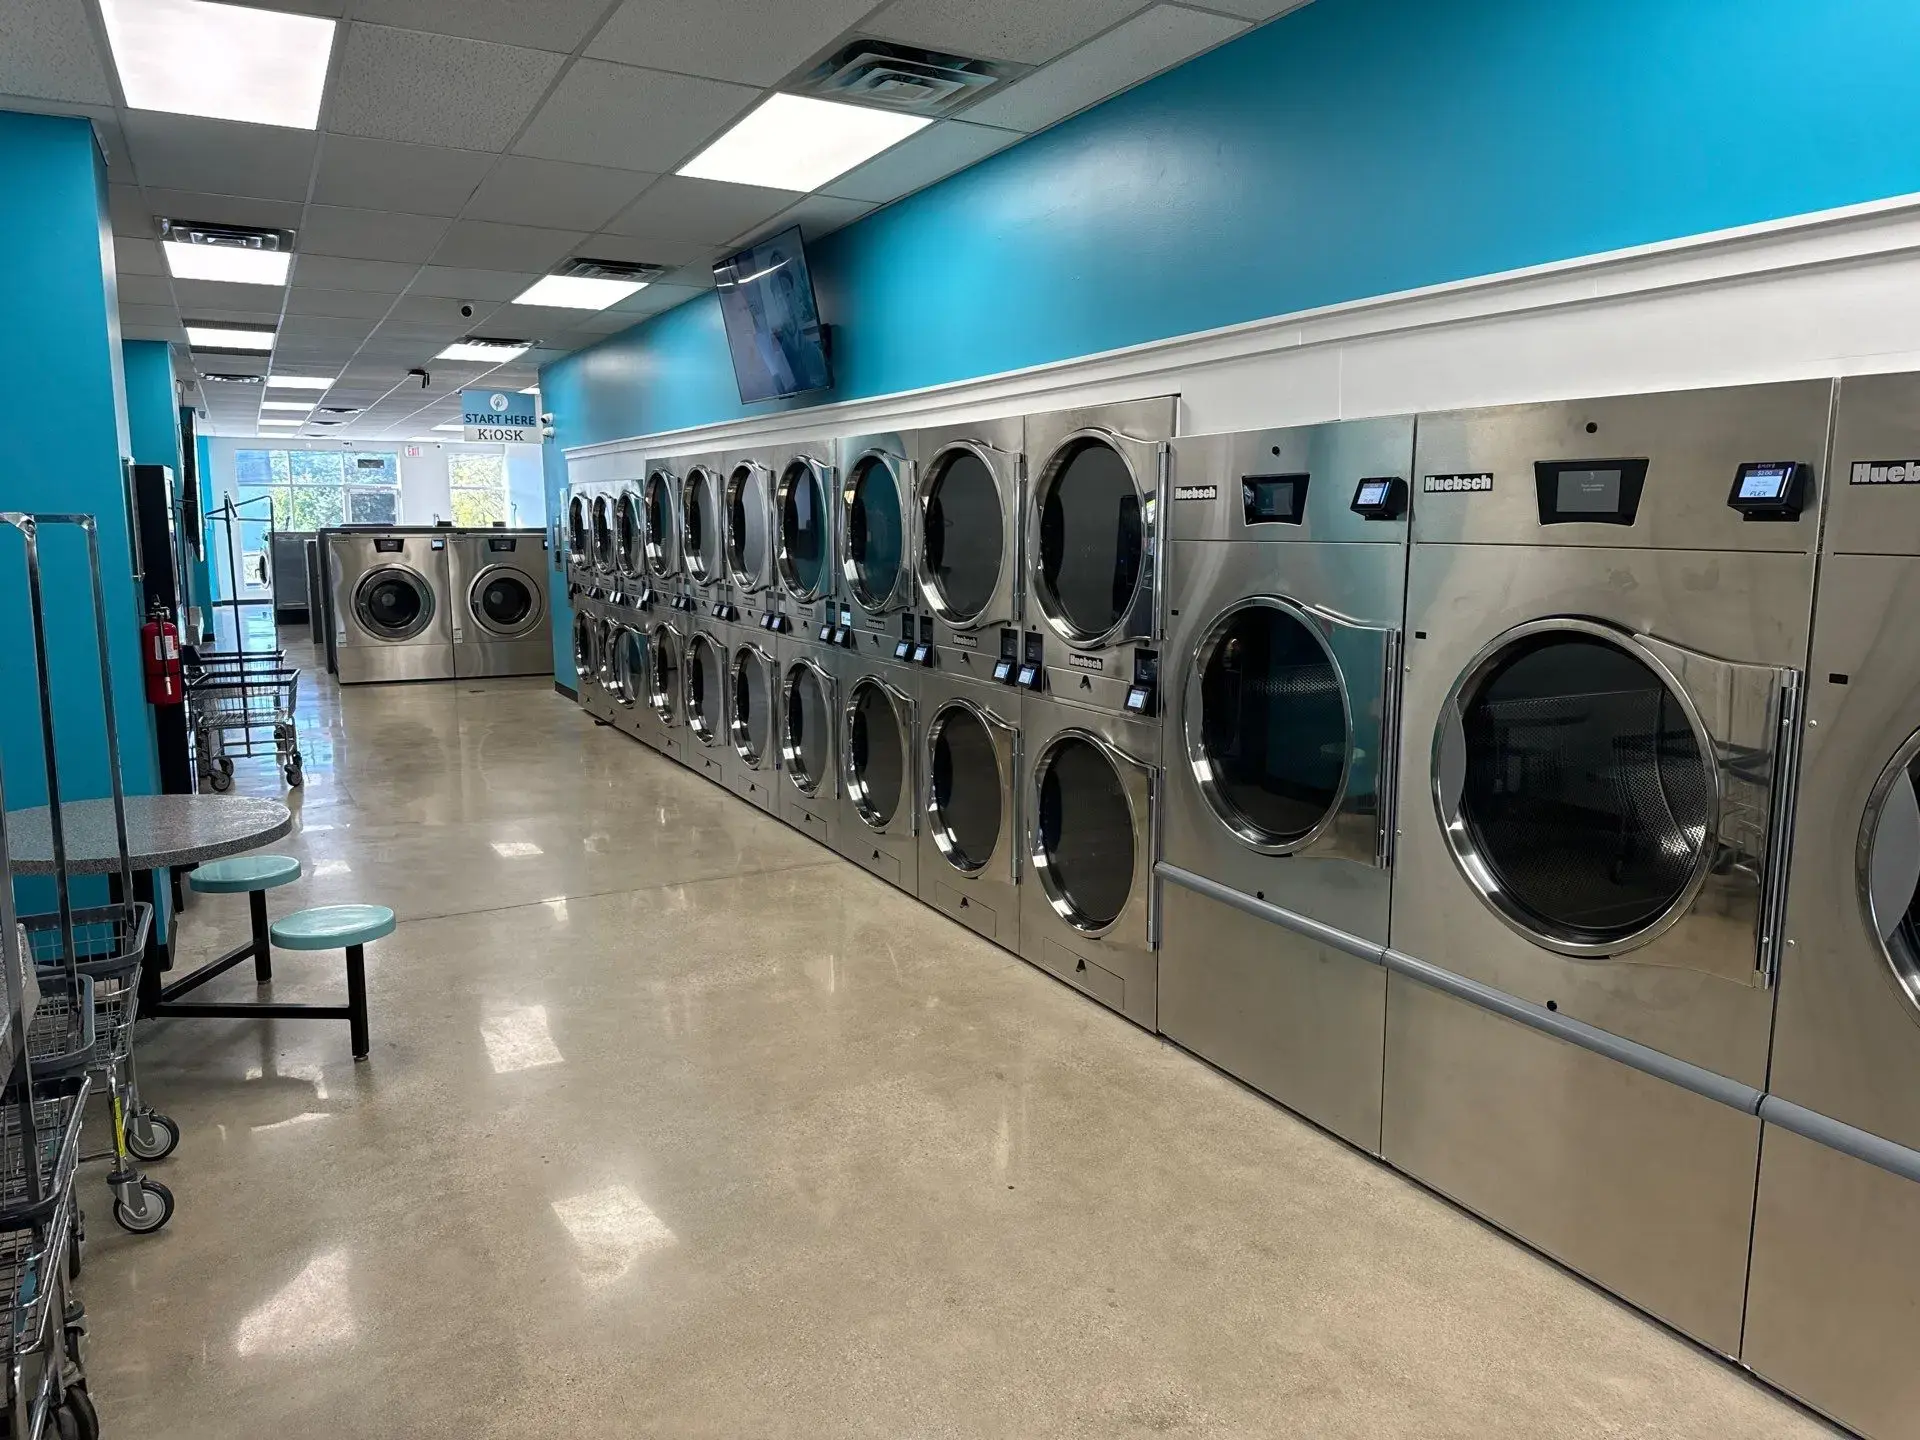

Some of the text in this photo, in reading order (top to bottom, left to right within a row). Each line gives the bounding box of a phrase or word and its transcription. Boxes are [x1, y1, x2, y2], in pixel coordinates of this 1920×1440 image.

[465, 413, 535, 425] START HERE
[1425, 474, 1492, 491] Huebsch
[1175, 486, 1216, 499] Huebsch
